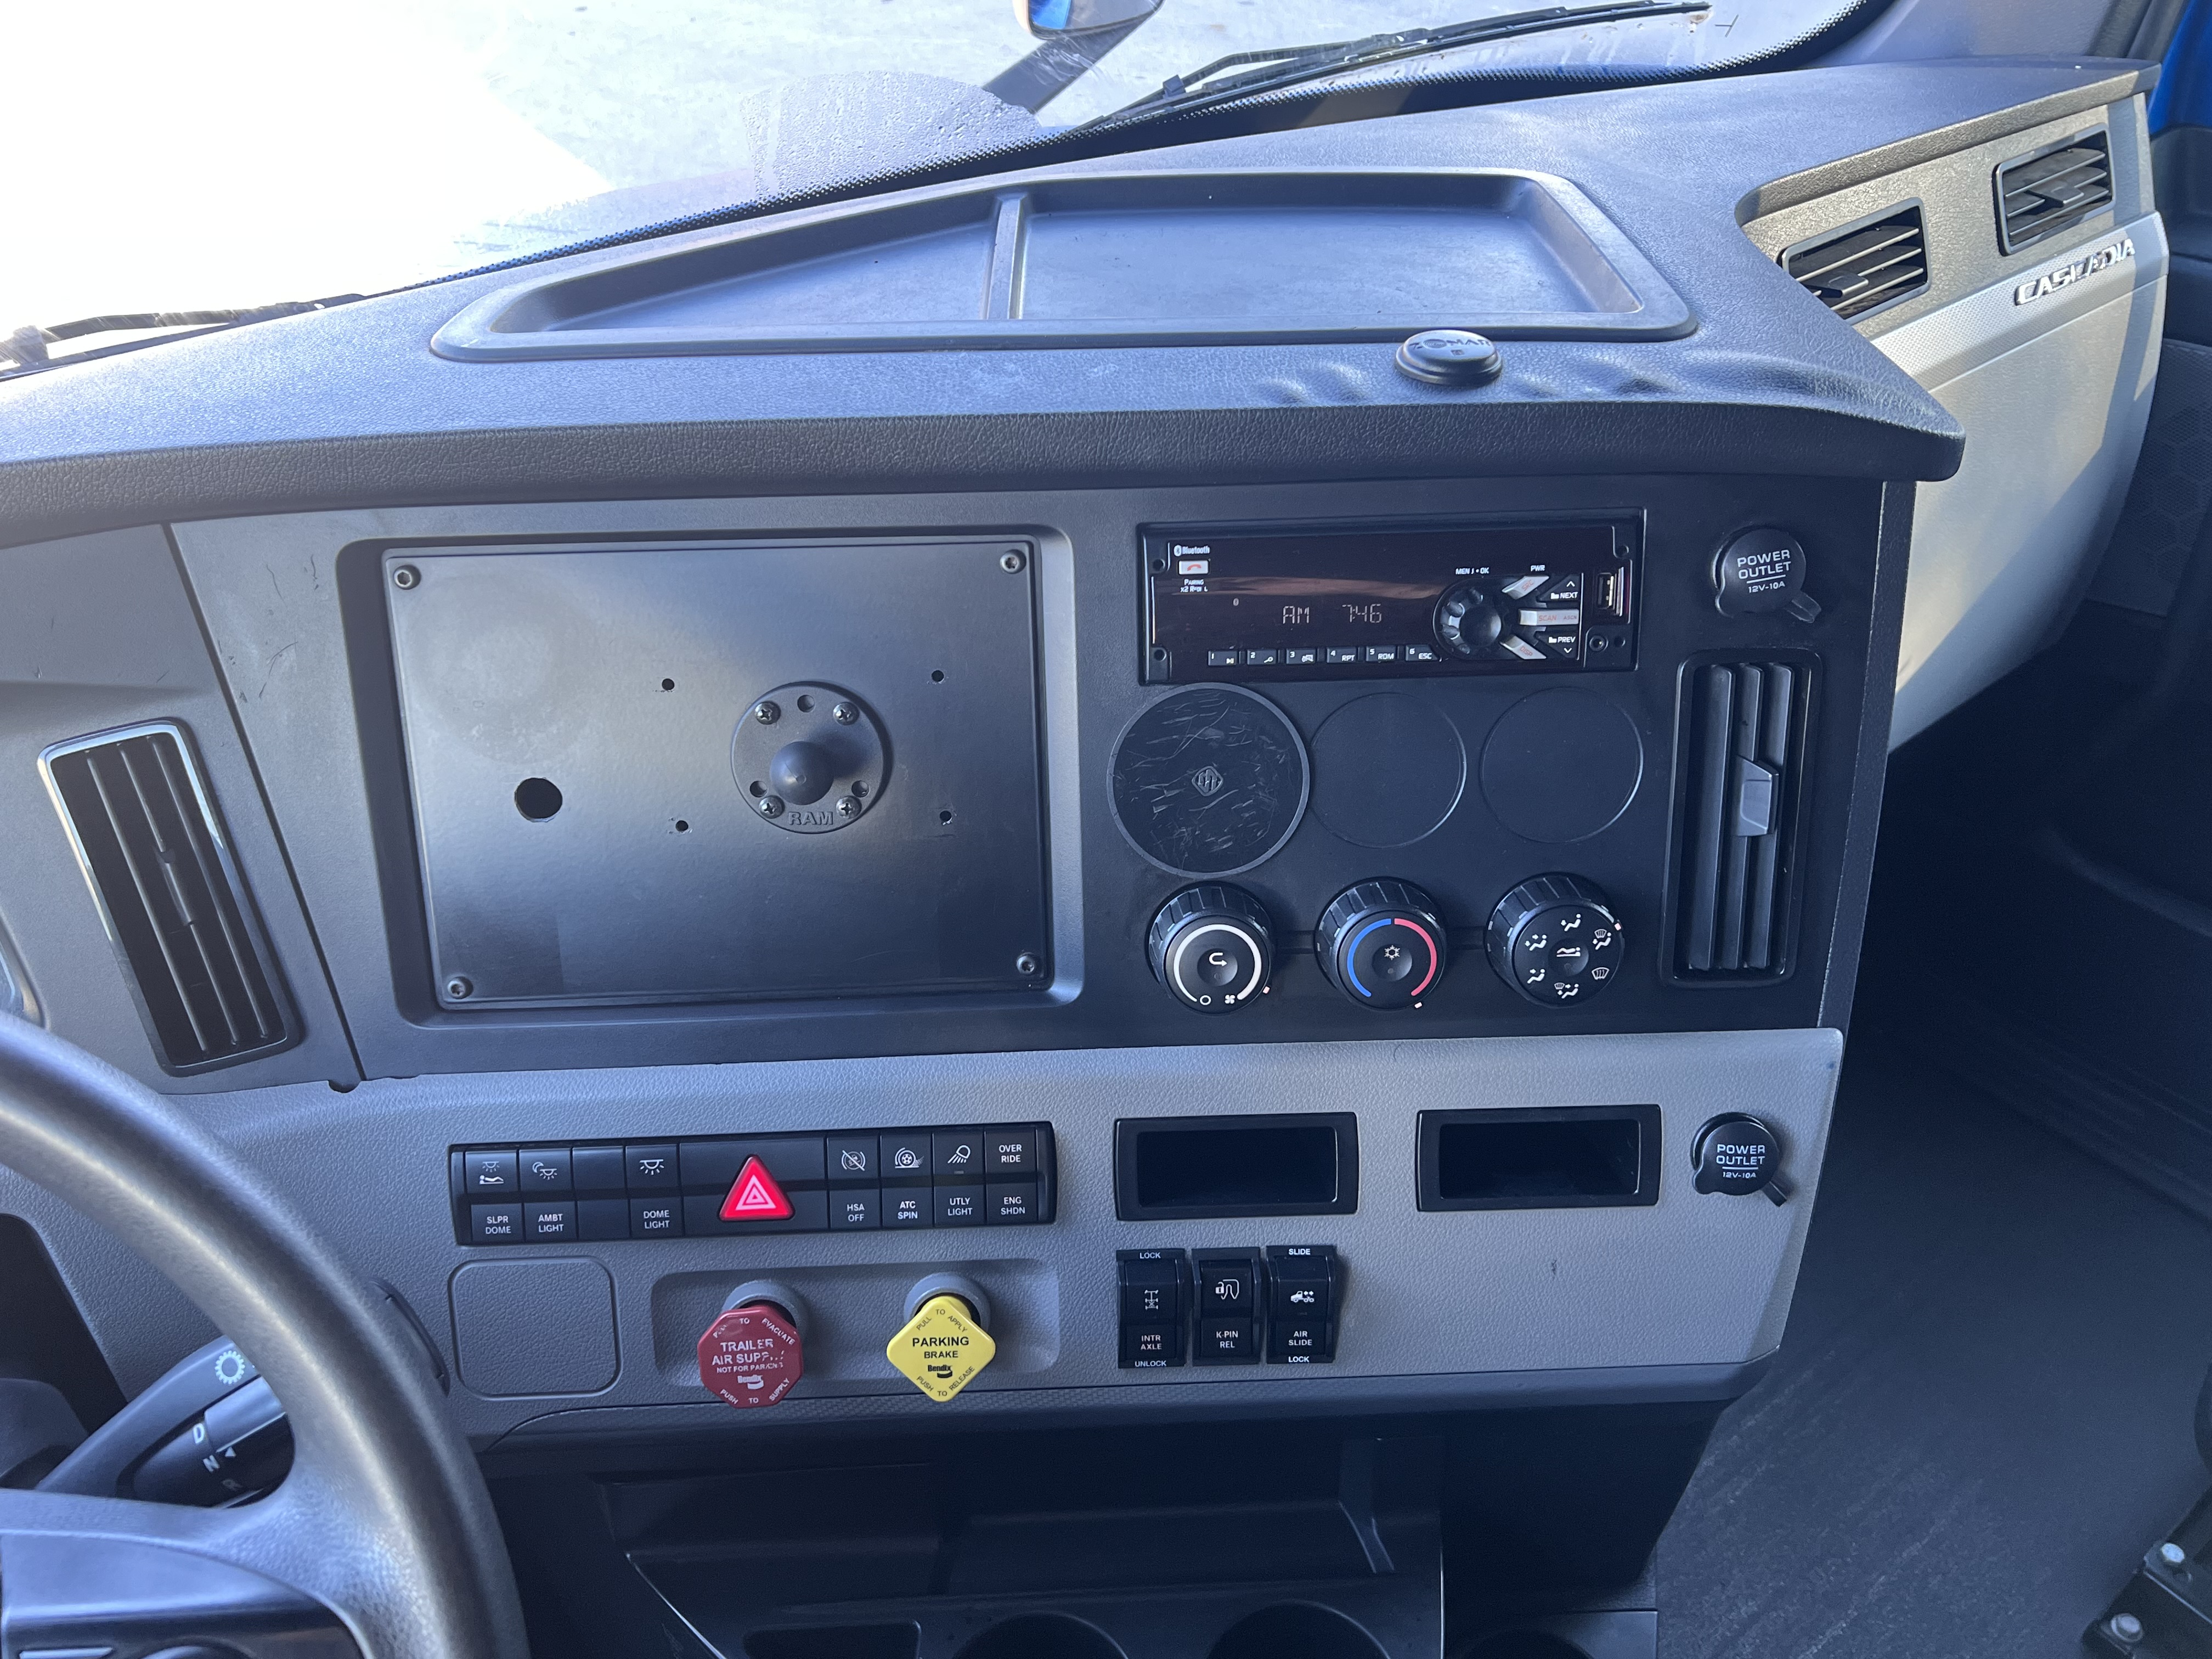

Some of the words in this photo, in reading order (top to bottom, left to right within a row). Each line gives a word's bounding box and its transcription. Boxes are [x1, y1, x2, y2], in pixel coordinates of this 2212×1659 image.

[1182, 545, 1210, 555] Bluetooth
[1737, 550, 1790, 567] POWER
[1738, 561, 1791, 579] OUTLET
[1522, 580, 1534, 591] SRC
[1748, 581, 1785, 593] 12V-10A
[1283, 606, 1310, 624] AM
[1519, 646, 1533, 657] DISP
[788, 811, 833, 825] RAM
[998, 1143, 1023, 1154] OVER
[1717, 1144, 1765, 1154] POWER
[1001, 1154, 1022, 1163] RIDE
[1716, 1155, 1765, 1165] OUTLET
[899, 1200, 916, 1210] ATC
[950, 1197, 970, 1206] UTLY
[1003, 1197, 1022, 1205] ENG
[847, 1203, 865, 1212] HSA
[947, 1207, 973, 1216] LIGHT
[1001, 1206, 1026, 1215] SHDN
[538, 1213, 563, 1222] AMBT
[644, 1210, 669, 1219] DOME
[848, 1213, 865, 1222] OFF
[898, 1210, 918, 1220] SPIN
[486, 1216, 509, 1224] SLPR
[644, 1220, 670, 1229] LIGHT
[485, 1226, 511, 1234] DOME
[539, 1223, 564, 1233] LIGHT
[916, 1317, 932, 1331] PULL
[947, 1315, 968, 1333] APPLY
[761, 1318, 795, 1345] EVACUATE
[1216, 1330, 1239, 1339] K-PIN
[720, 1338, 774, 1352] TRAILER
[912, 1336, 969, 1347] PARKING
[1220, 1340, 1235, 1348] REL
[712, 1355, 733, 1365] AIR
[736, 1350, 785, 1363] SUPP
[924, 1351, 958, 1359] BRAKE
[1288, 1356, 1310, 1364] LOCK
[916, 1376, 934, 1391] PUSH
[949, 1366, 975, 1391] RELEASE
[720, 1389, 738, 1404] PUSH
[769, 1378, 789, 1401] SUPPLY
[193, 1423, 205, 1444] D
[203, 1455, 219, 1472] N
